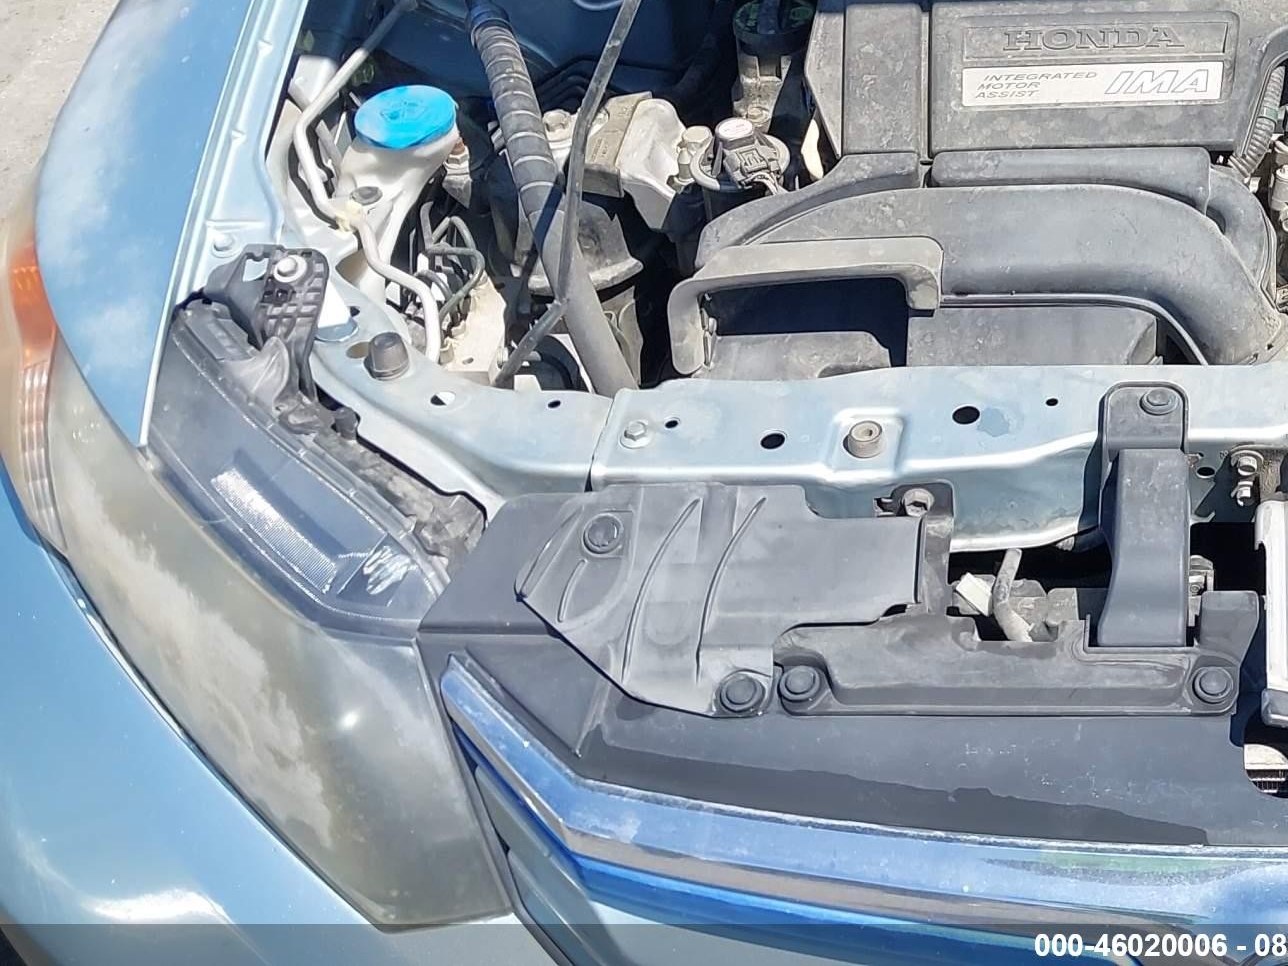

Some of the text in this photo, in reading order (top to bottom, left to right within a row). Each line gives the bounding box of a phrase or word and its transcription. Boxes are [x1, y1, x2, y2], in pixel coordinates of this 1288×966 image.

[1003, 25, 1185, 51] HONDA
[983, 71, 1098, 82] INTEGRATED
[1104, 68, 1209, 95] IMA
[977, 81, 1041, 91] MOTOR
[975, 90, 1040, 99] ASSIST
